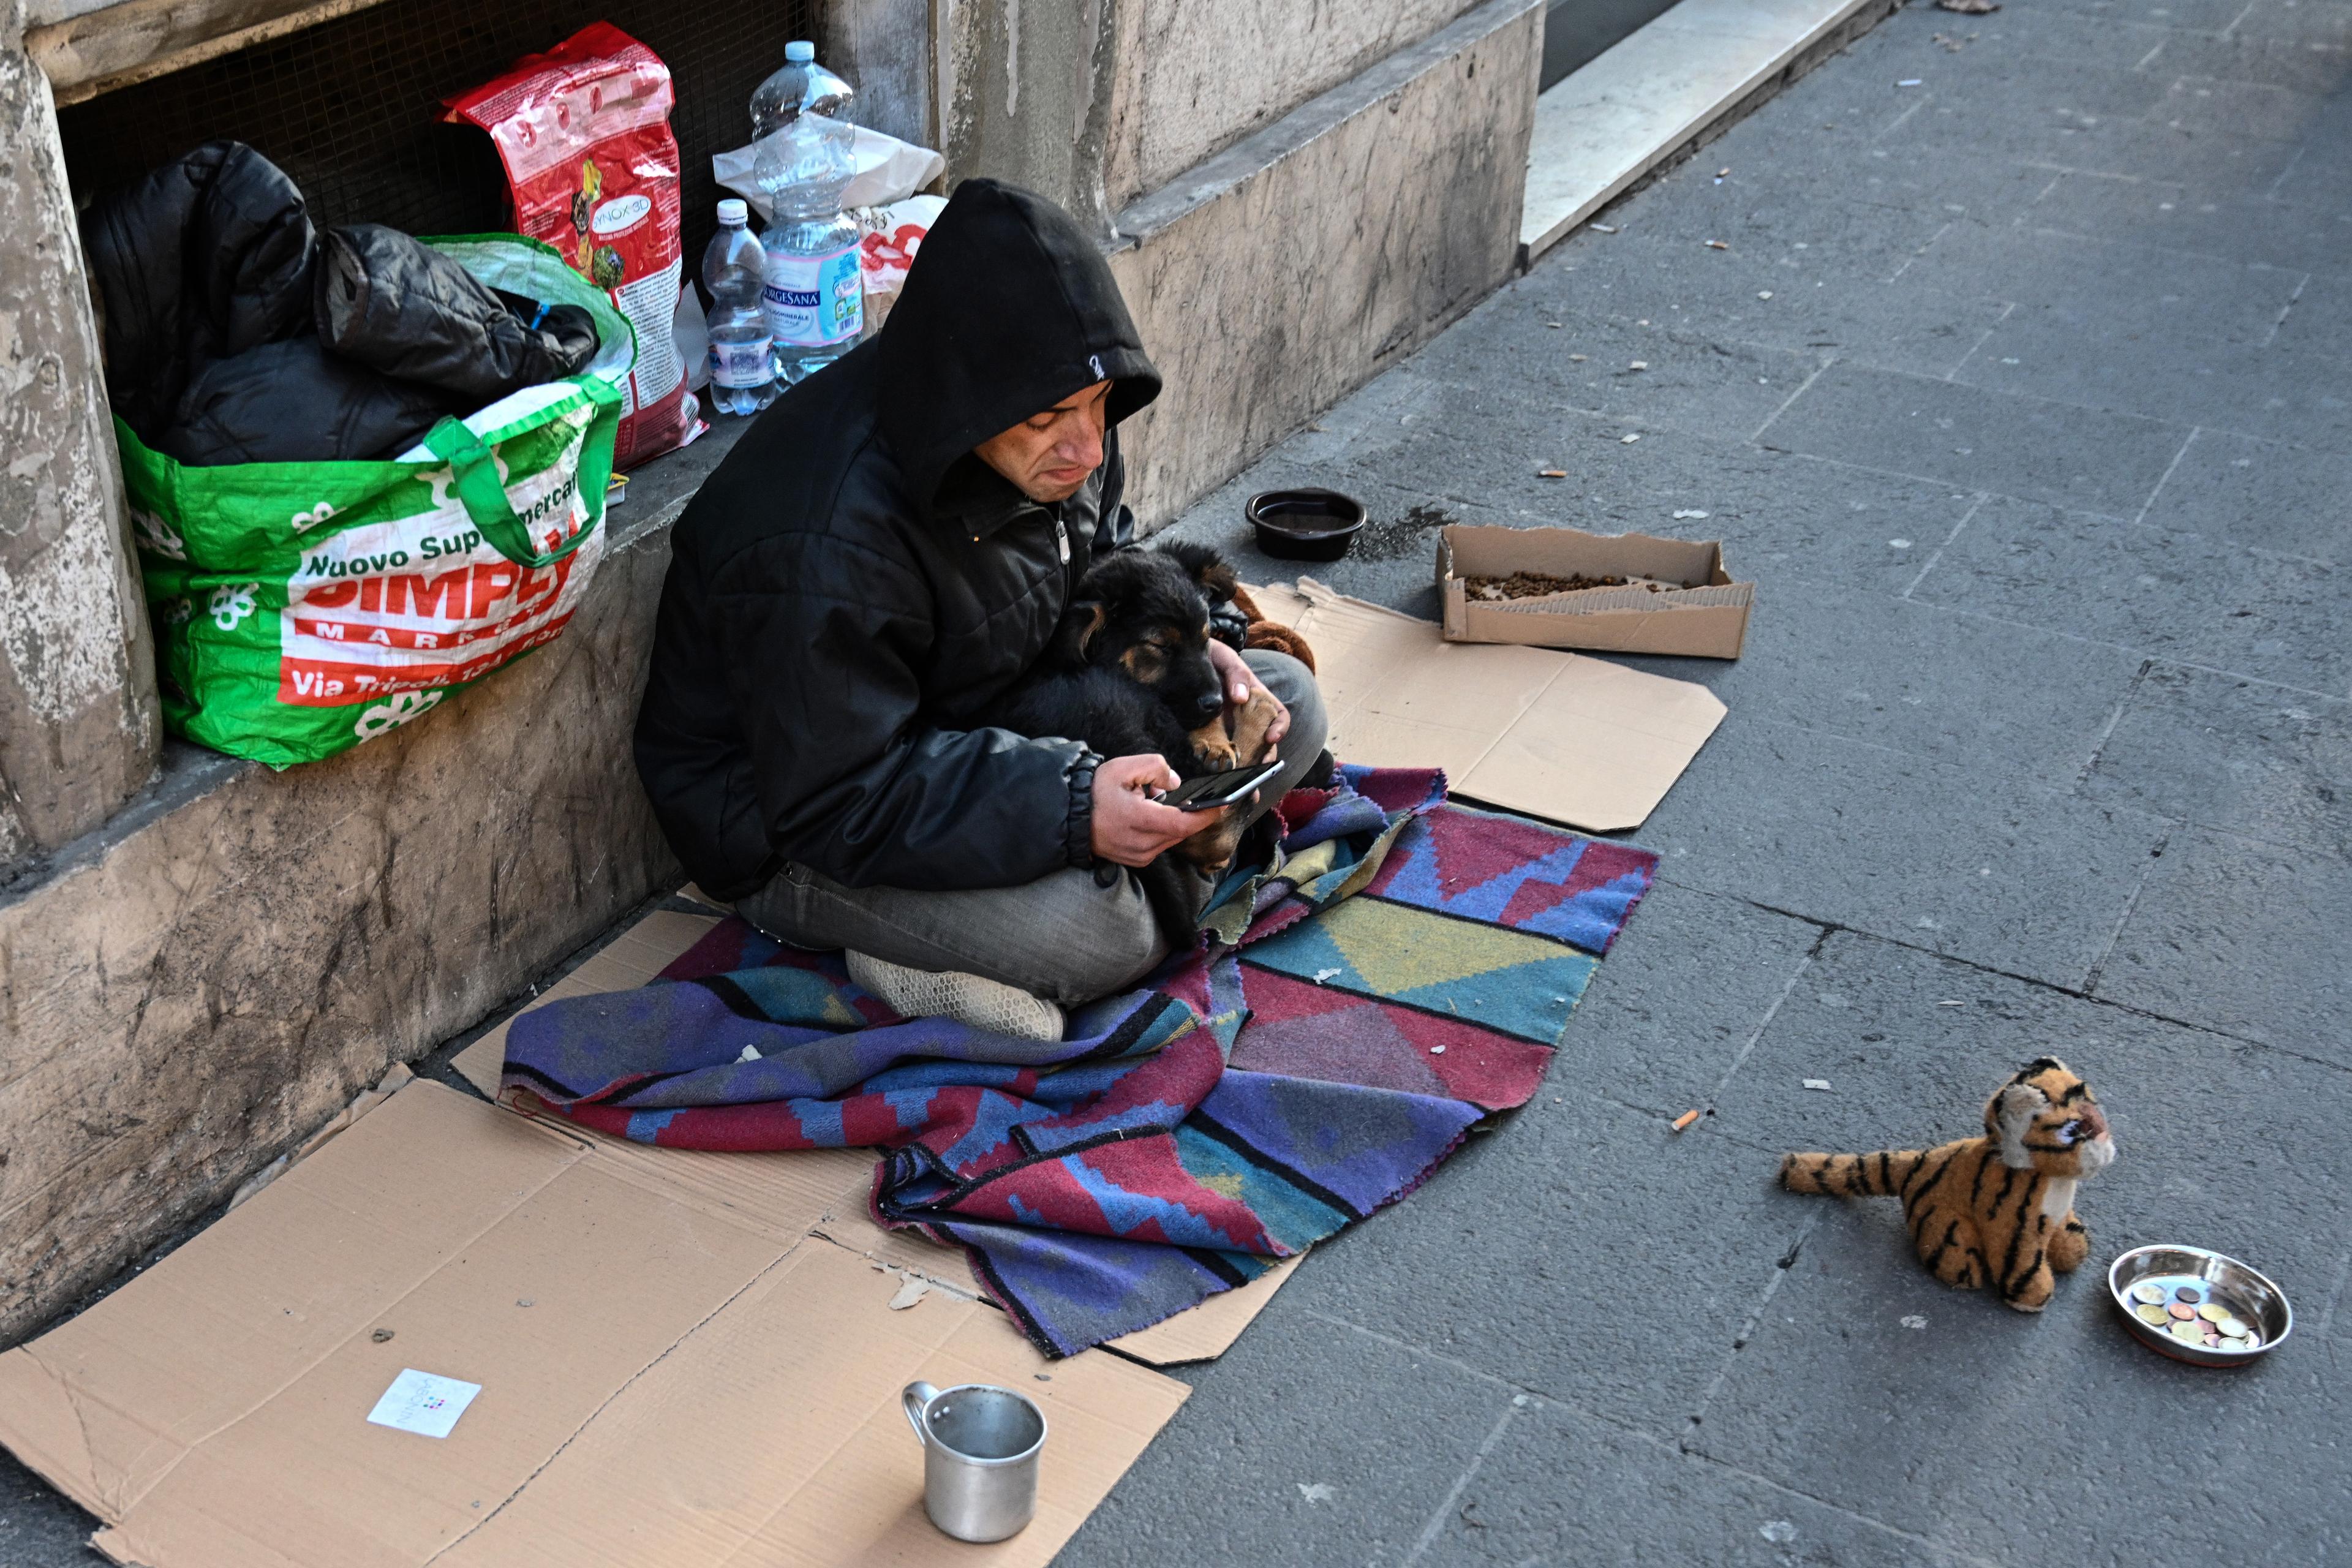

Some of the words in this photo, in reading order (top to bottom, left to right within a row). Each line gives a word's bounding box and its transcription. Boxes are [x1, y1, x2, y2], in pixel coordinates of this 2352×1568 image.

[631, 198, 649, 213] 3D
[763, 285, 818, 306] ORGESANA
[306, 550, 409, 578] Nuovo
[420, 468, 578, 560] Supmercat
[315, 603, 540, 649] MARKET
[292, 669, 344, 698] Via
[519, 625, 565, 652] ROM
